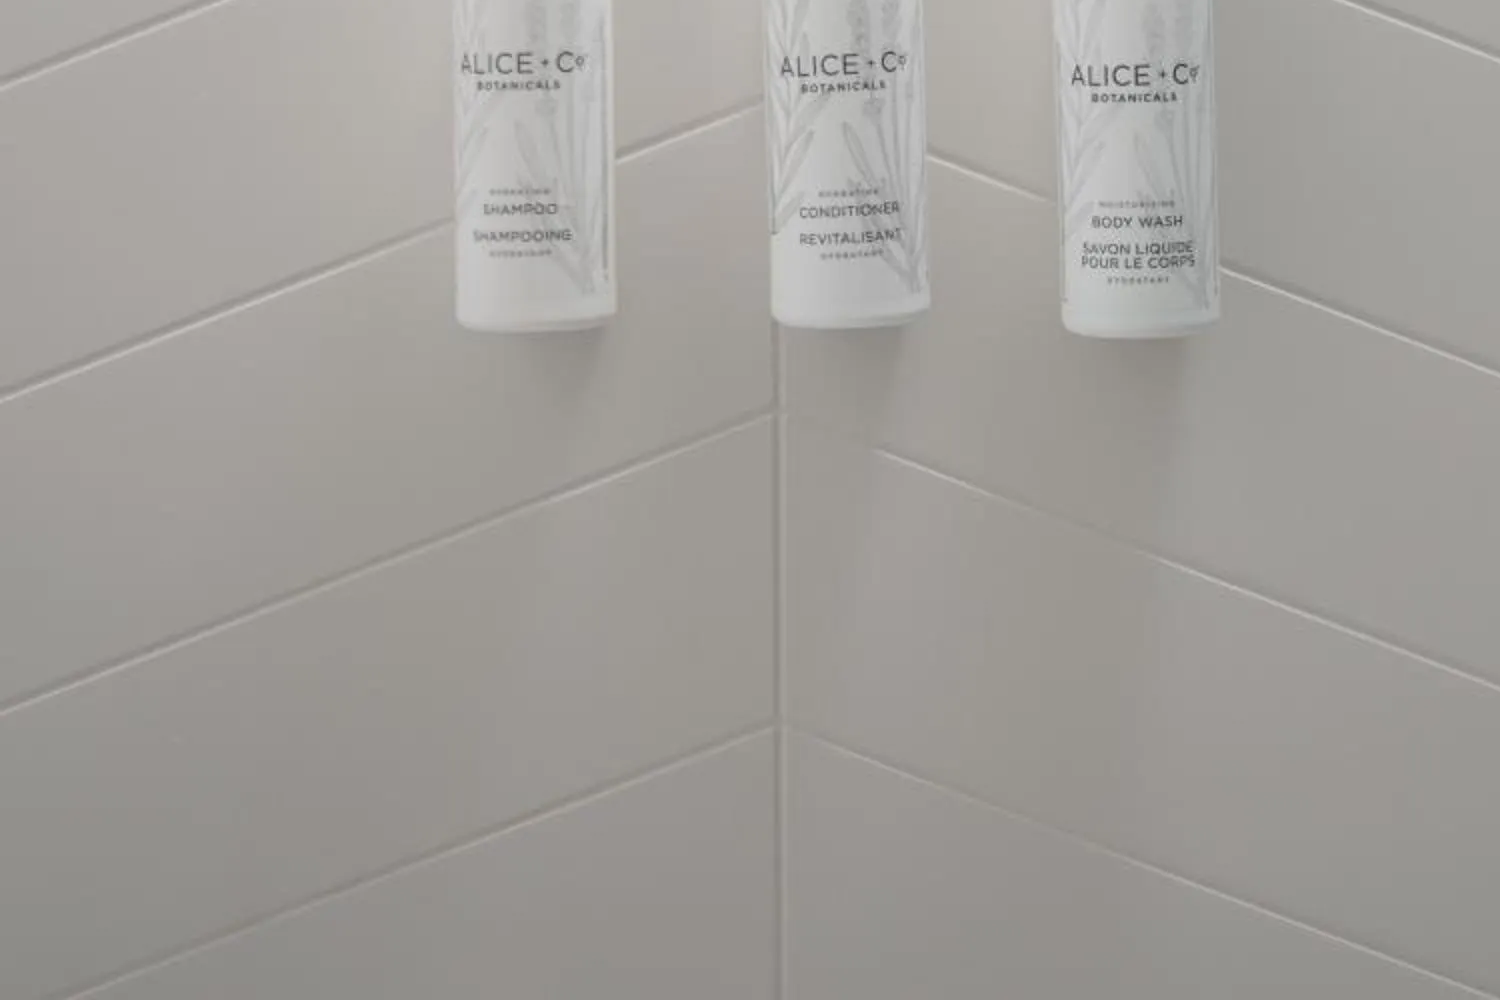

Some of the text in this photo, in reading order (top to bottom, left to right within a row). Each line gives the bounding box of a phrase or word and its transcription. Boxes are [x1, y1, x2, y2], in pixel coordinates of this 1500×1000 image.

[461, 51, 534, 75] ALICE
[780, 53, 860, 78] ALICE
[1071, 63, 1152, 87] ALICE
[476, 79, 562, 91] BOTANICALS
[801, 79, 887, 94] BOTANICALS
[1091, 91, 1178, 103] BOTANICALS
[483, 202, 558, 215] SHAMPOO
[799, 200, 900, 219] CONDITIONER
[1091, 215, 1183, 229] BODY WASH
[473, 228, 574, 243] SHAMPOOING
[799, 227, 904, 246] REVITALISANT
[1083, 241, 1194, 255] SAVON LIQUIDE
[1081, 254, 1196, 270] POUR LE CORPS
